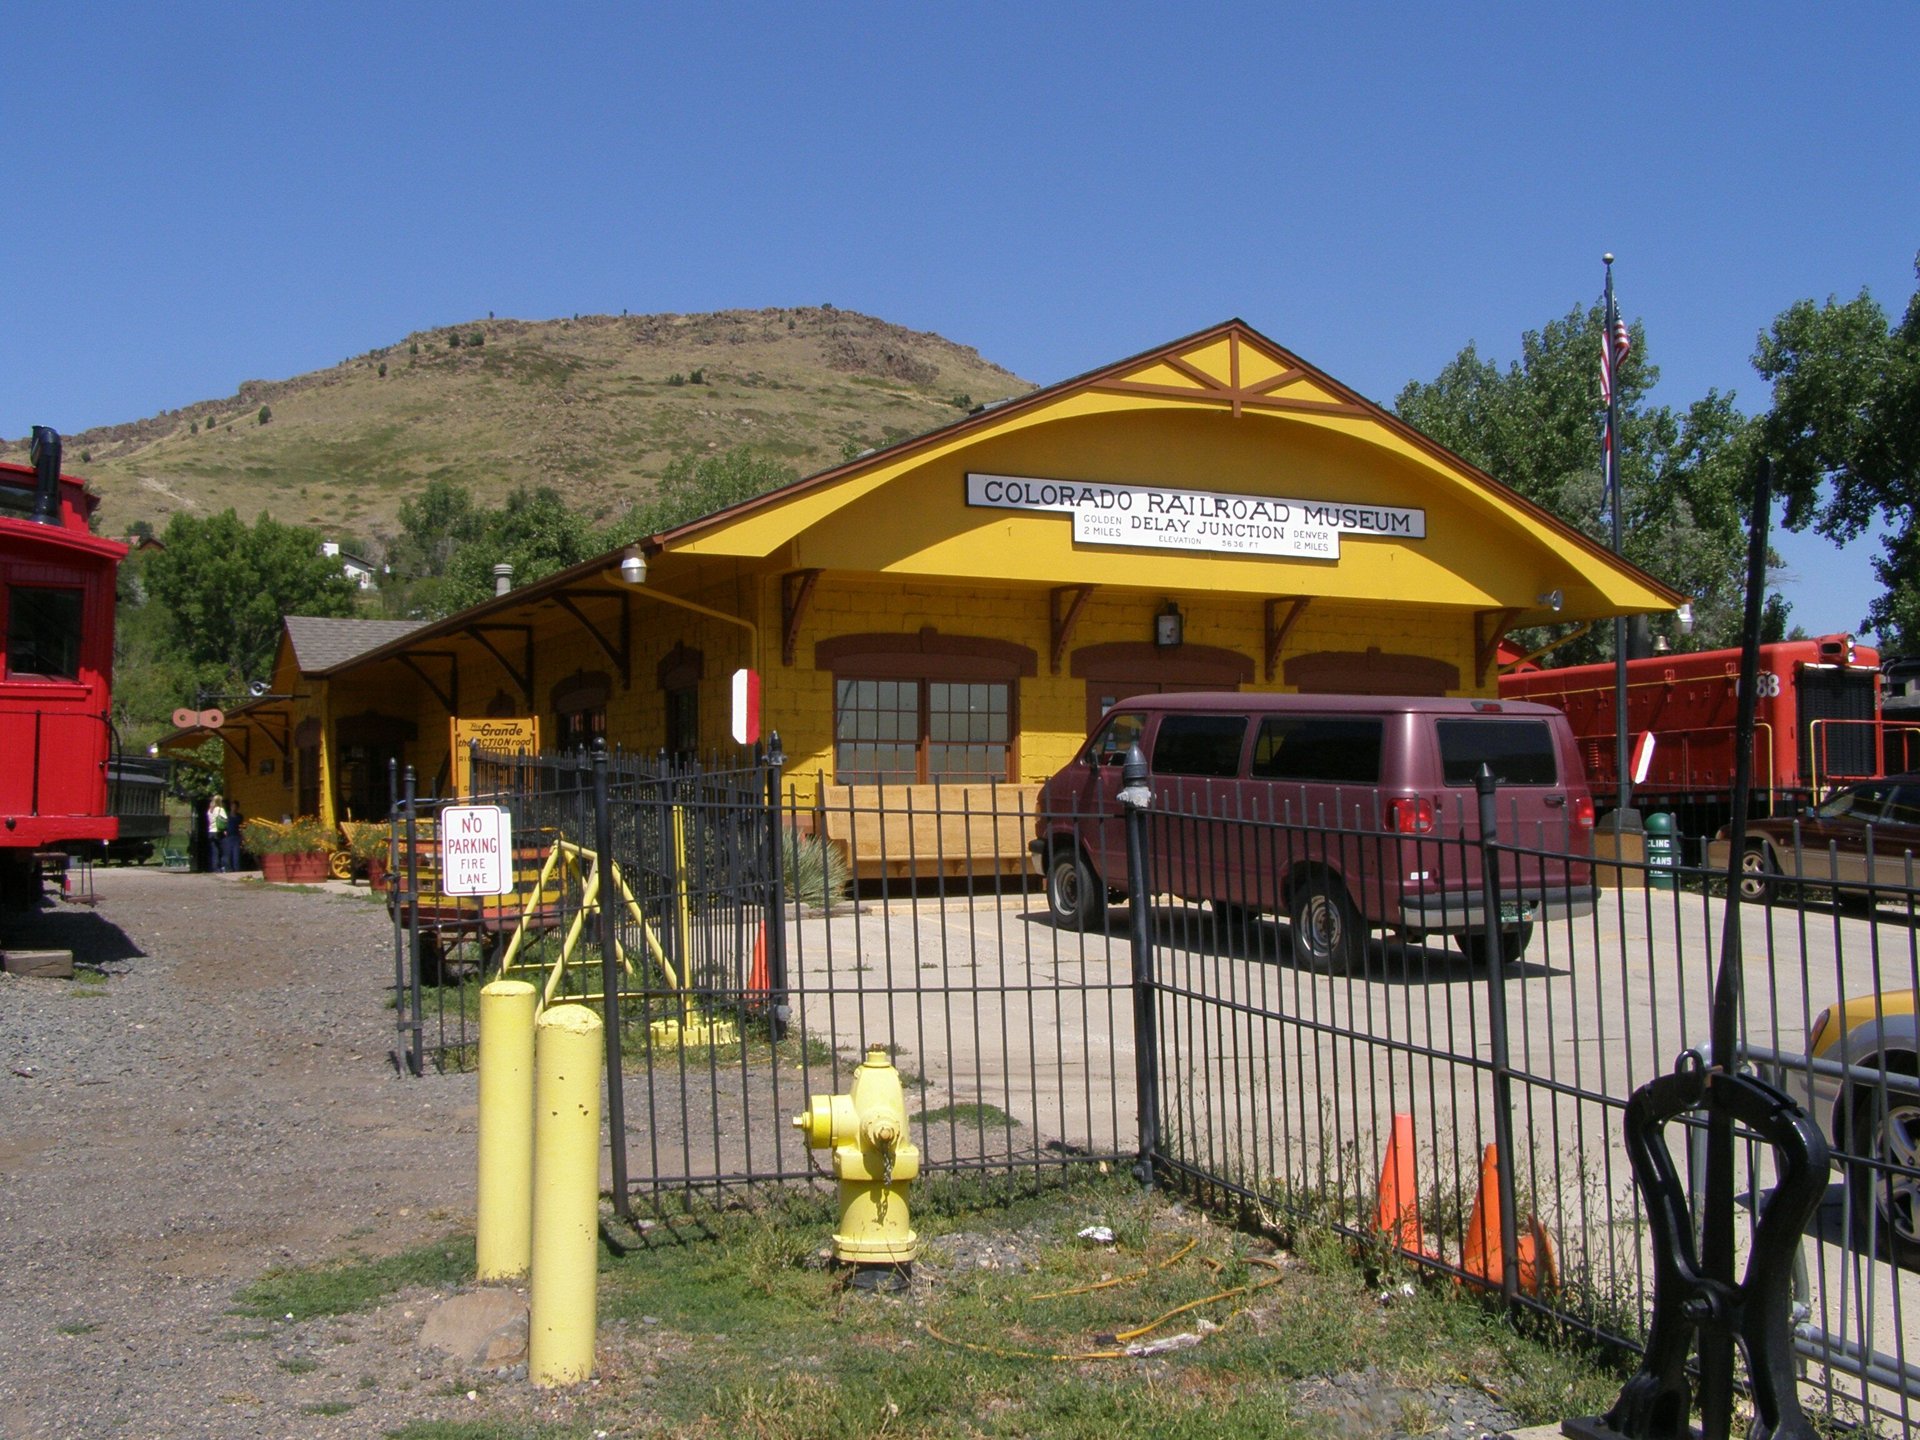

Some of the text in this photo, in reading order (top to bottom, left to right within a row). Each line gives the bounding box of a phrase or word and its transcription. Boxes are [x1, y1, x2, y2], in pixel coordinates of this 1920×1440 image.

[984, 480, 1411, 533] COLORADO RAILROAD MUSEUM
[1083, 514, 1122, 525] GOLDEN
[1083, 526, 1122, 537] 2 MILES
[1131, 515, 1285, 539] DELAY JUNCTION
[1158, 535, 1202, 545] ELEVATION
[1293, 530, 1328, 540] DENVER
[1293, 542, 1329, 552] 12 MILES
[480, 722, 523, 737] Grande
[462, 817, 482, 834] NO
[448, 837, 497, 854] PARKING
[460, 858, 486, 869] FIRE
[1650, 856, 1672, 865] CANS
[459, 873, 488, 884] LANE
